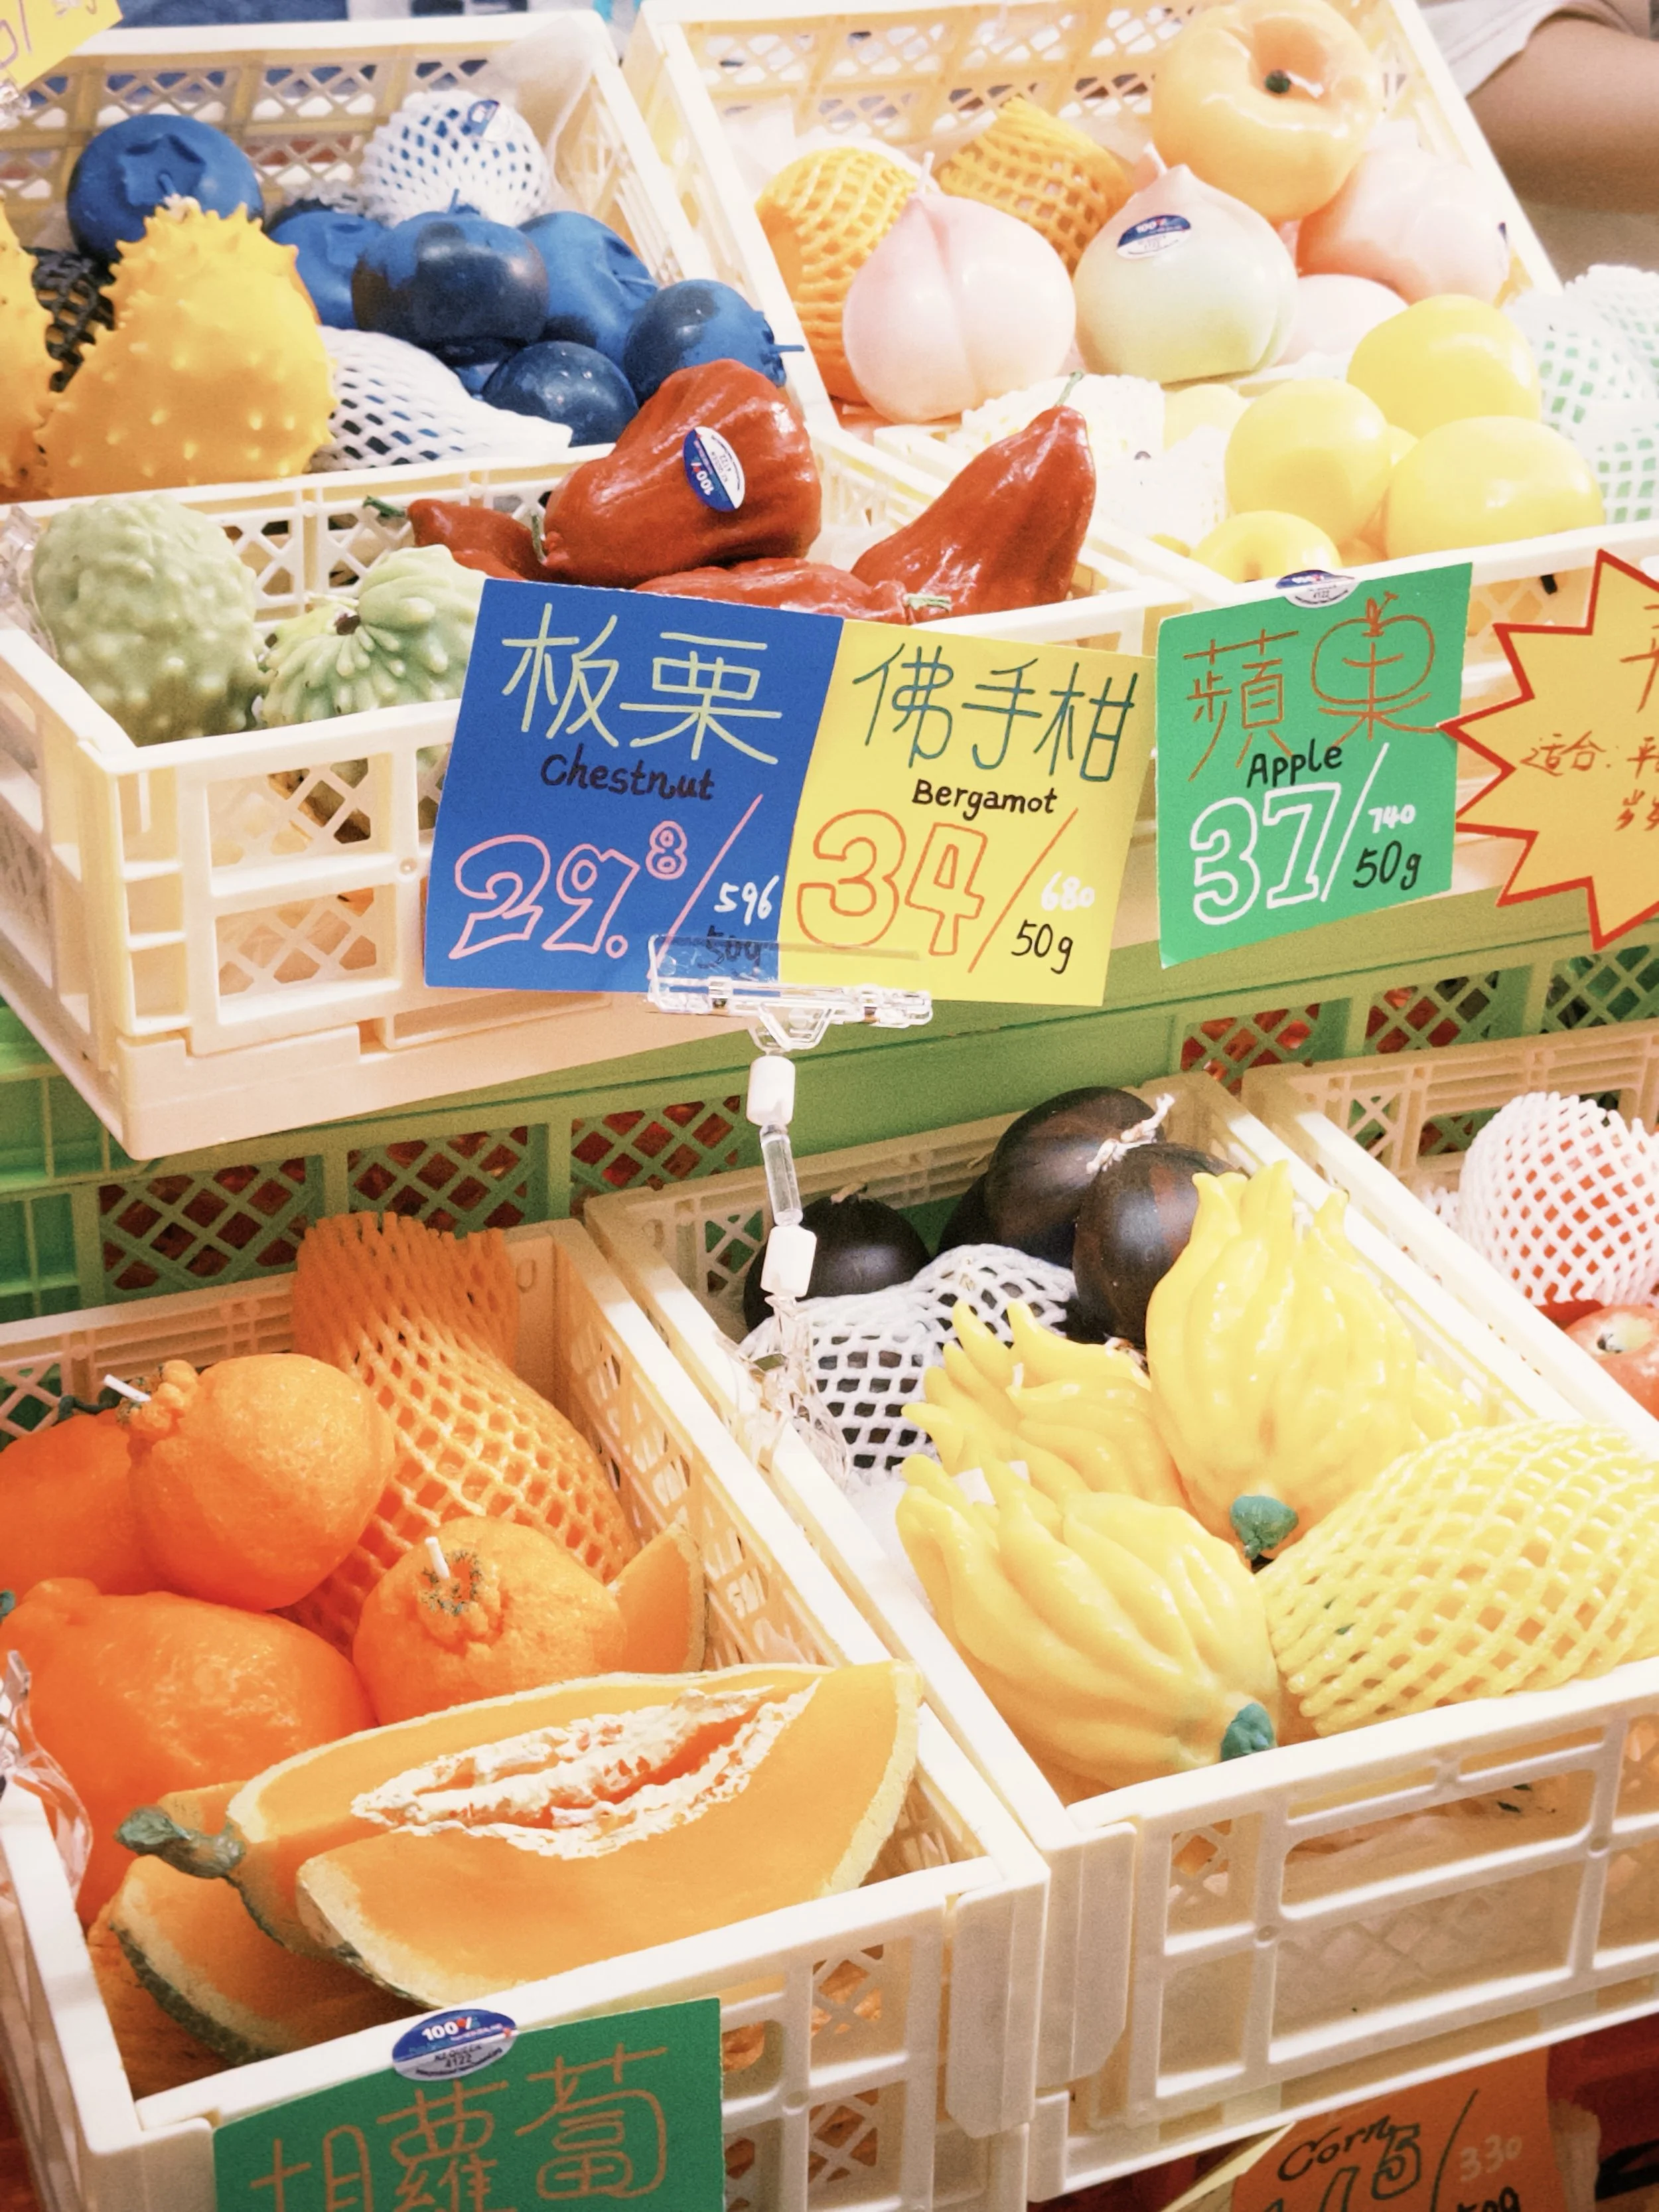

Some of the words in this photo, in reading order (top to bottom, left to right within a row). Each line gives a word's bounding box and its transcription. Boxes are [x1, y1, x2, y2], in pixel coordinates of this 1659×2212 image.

[501, 603, 782, 765] 板栗
[1183, 592, 1440, 782] 蘋果
[853, 643, 1139, 782] 佛手柑
[540, 743, 715, 800] Chestnut
[1247, 738, 1343, 788] Apple
[911, 778, 1058, 821] Bergamot
[1368, 803, 1416, 834] 740
[1040, 871, 1096, 911] 680
[1352, 840, 1422, 891] 50g
[713, 875, 780, 926] 596
[1011, 919, 1074, 975] 50g
[421, 2016, 481, 2041] 100%
[1278, 2114, 1392, 2181] Corn
[1460, 2134, 1522, 2182] 330
